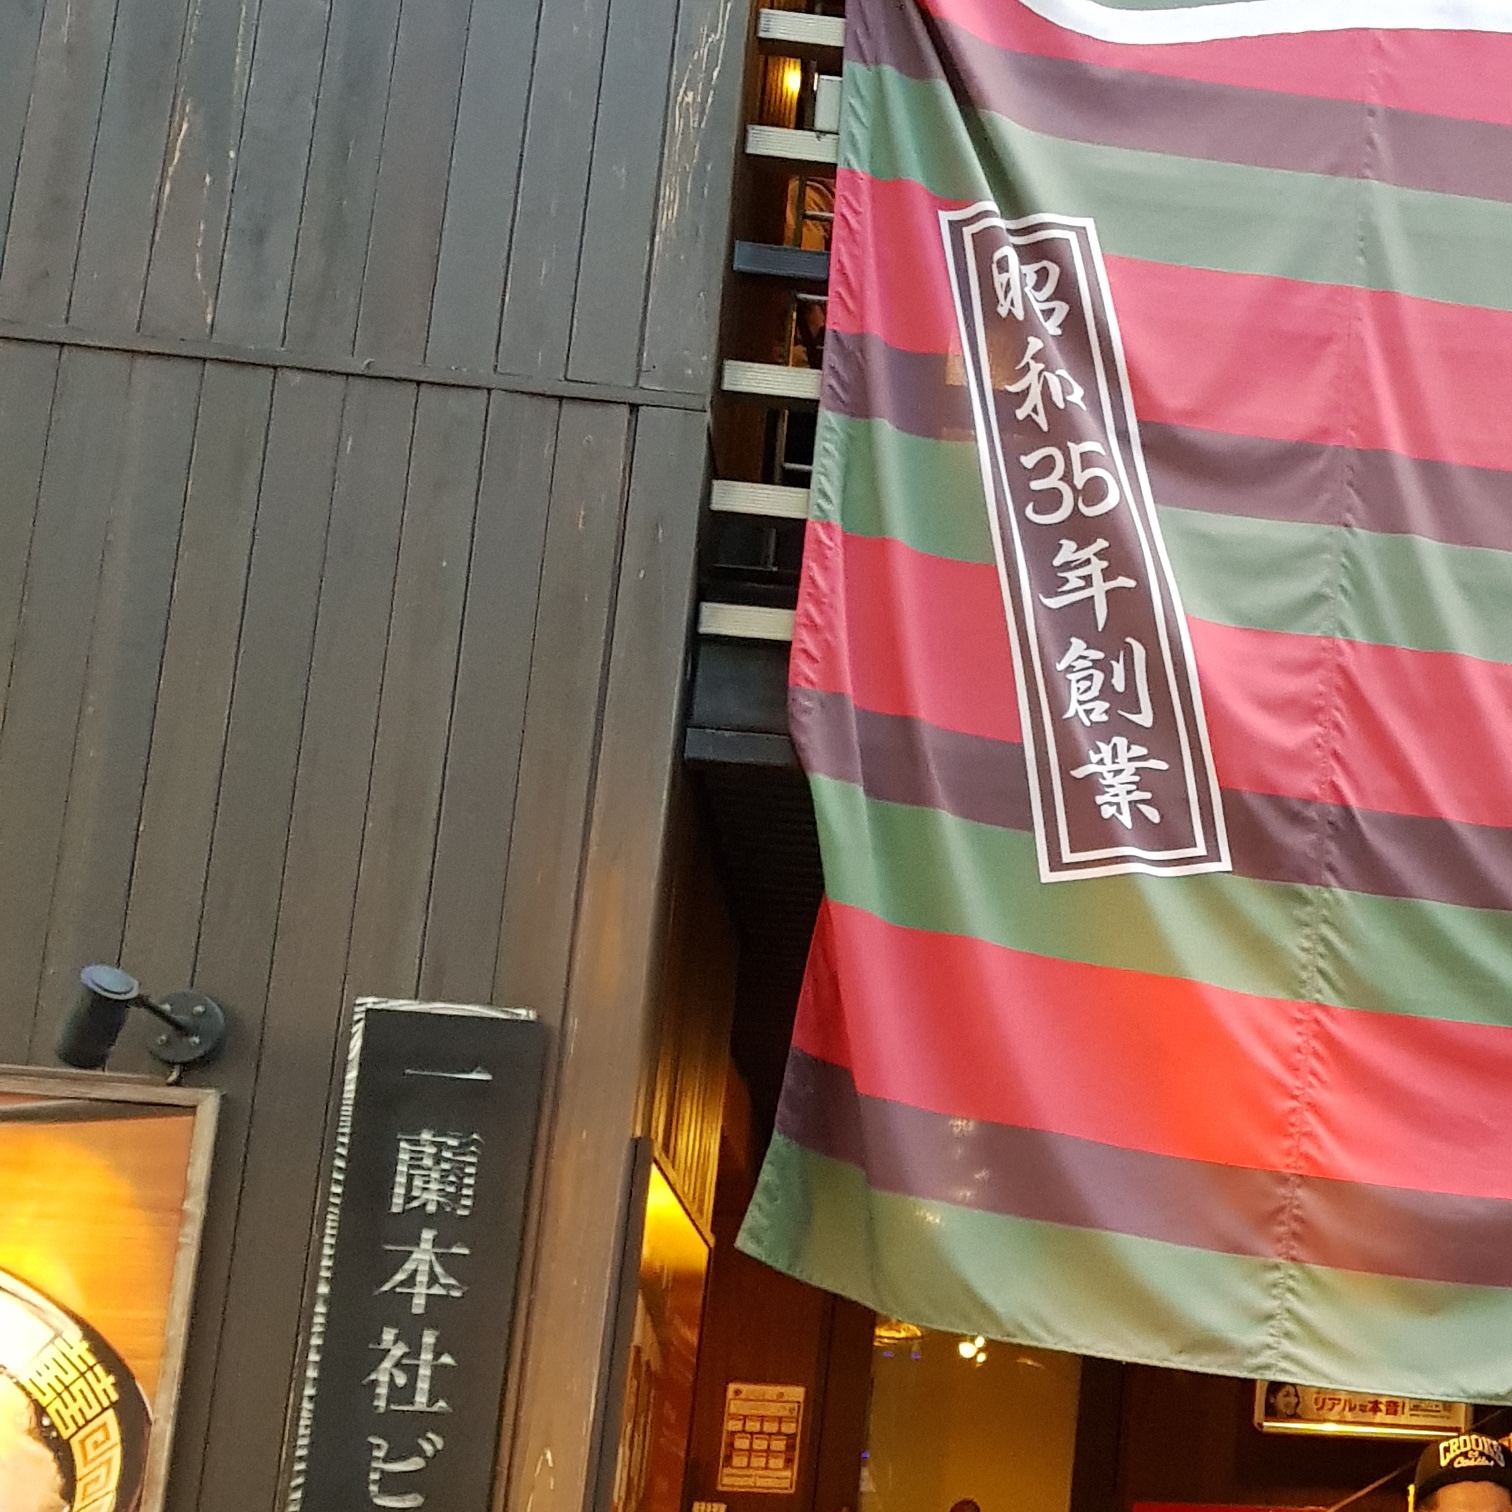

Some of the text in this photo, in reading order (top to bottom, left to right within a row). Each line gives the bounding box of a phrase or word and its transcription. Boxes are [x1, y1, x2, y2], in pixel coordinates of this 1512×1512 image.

[990, 246, 1170, 830] 昭和35年創業
